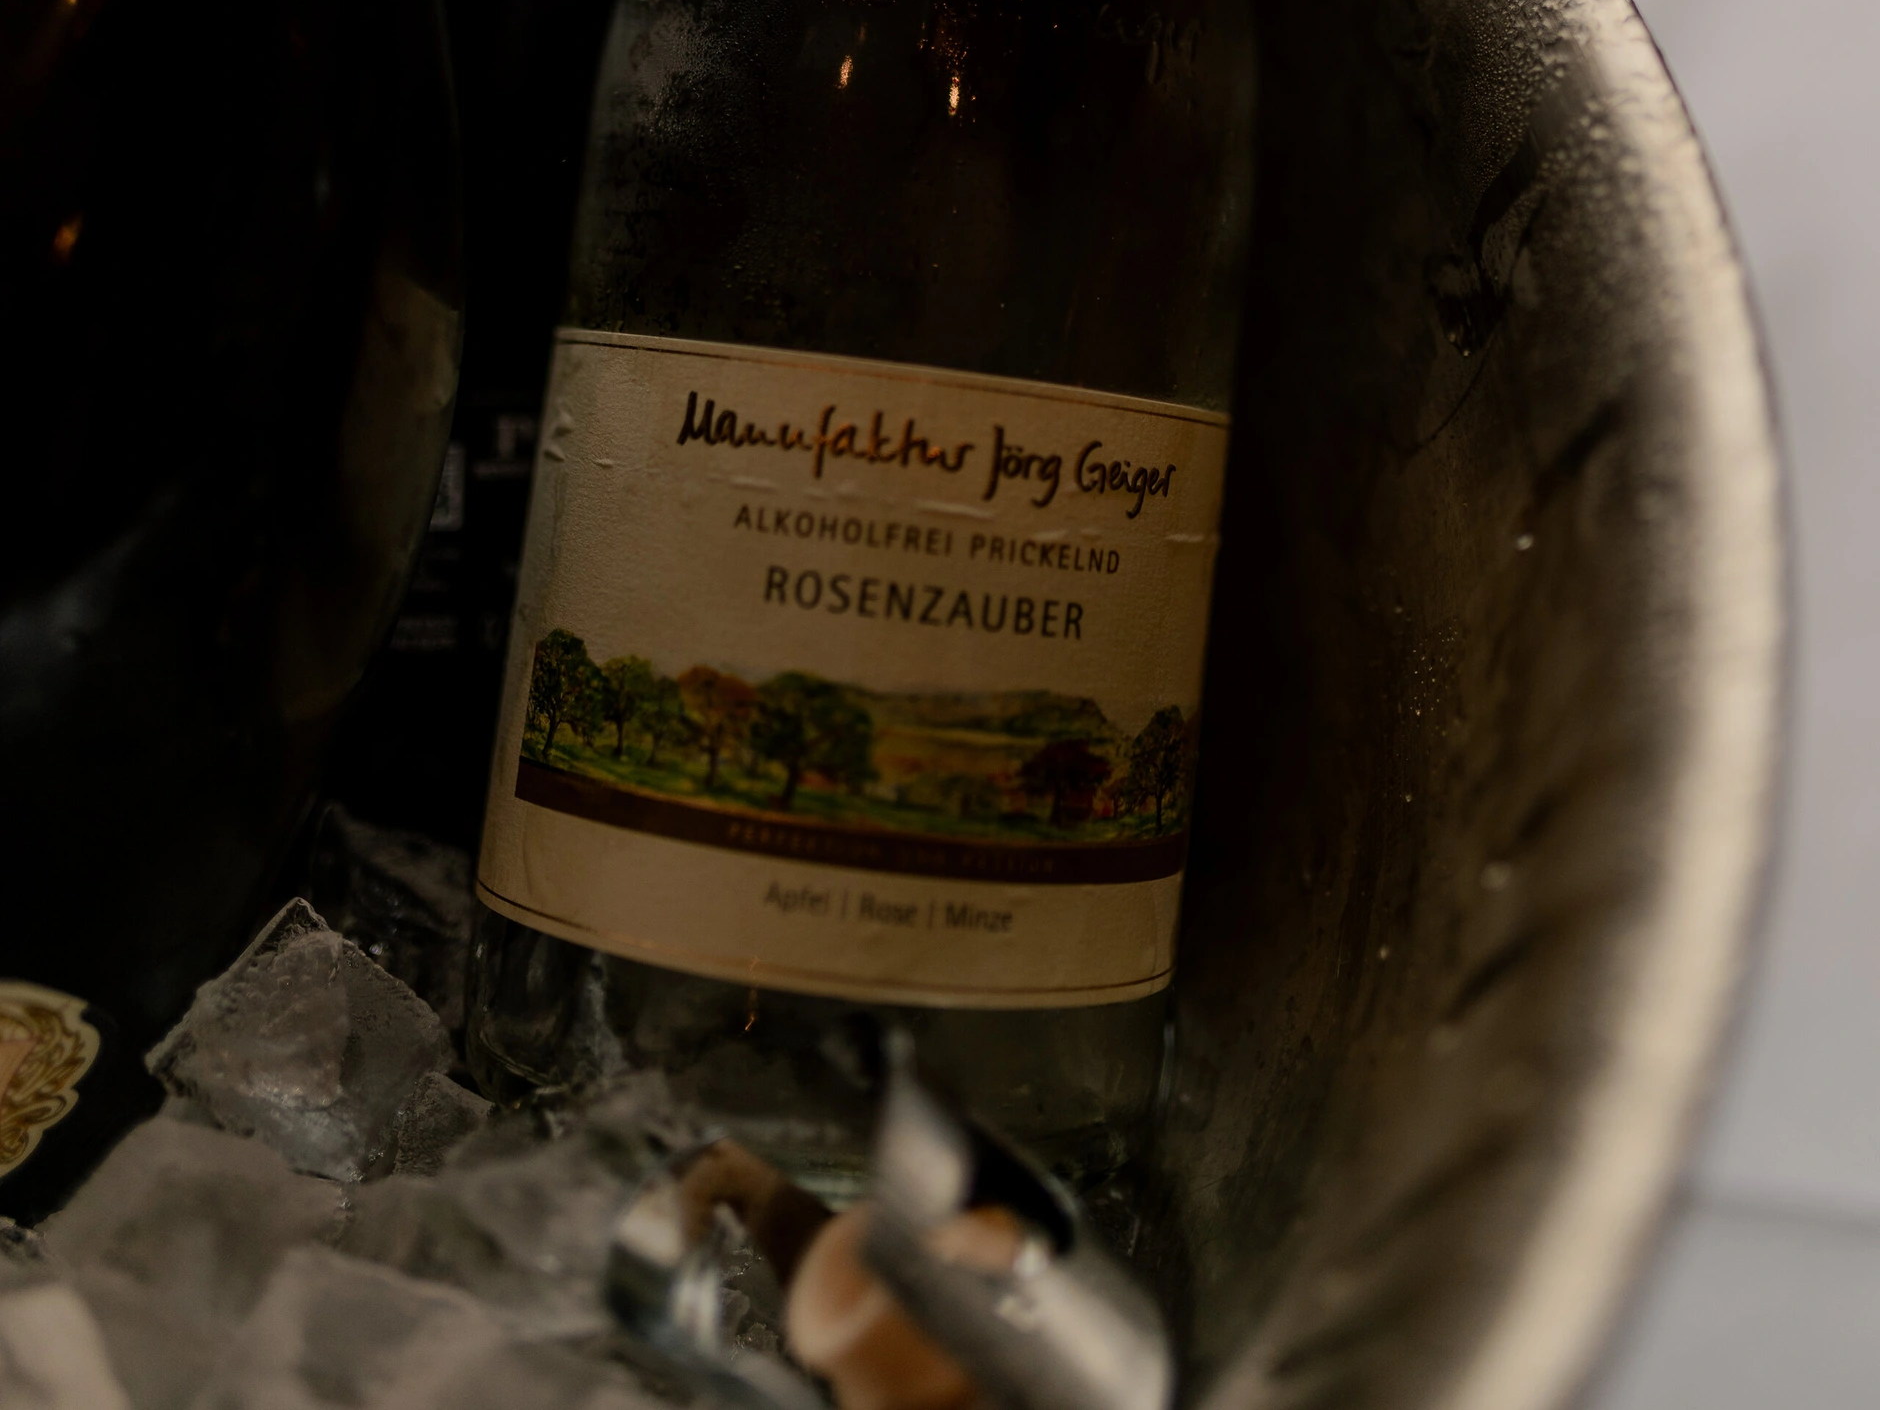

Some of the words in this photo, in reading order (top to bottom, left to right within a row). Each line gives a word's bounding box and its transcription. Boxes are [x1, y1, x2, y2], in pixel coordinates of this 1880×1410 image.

[677, 391, 974, 478] Manufaktur
[983, 424, 1061, 507] Jörg
[1074, 442, 1176, 519] Geiger
[733, 504, 953, 556] ALKOHOLFREI
[969, 533, 1120, 575] PRICKELND
[763, 565, 1084, 640] ROSENZAUBER
[945, 901, 1013, 933] Minze
